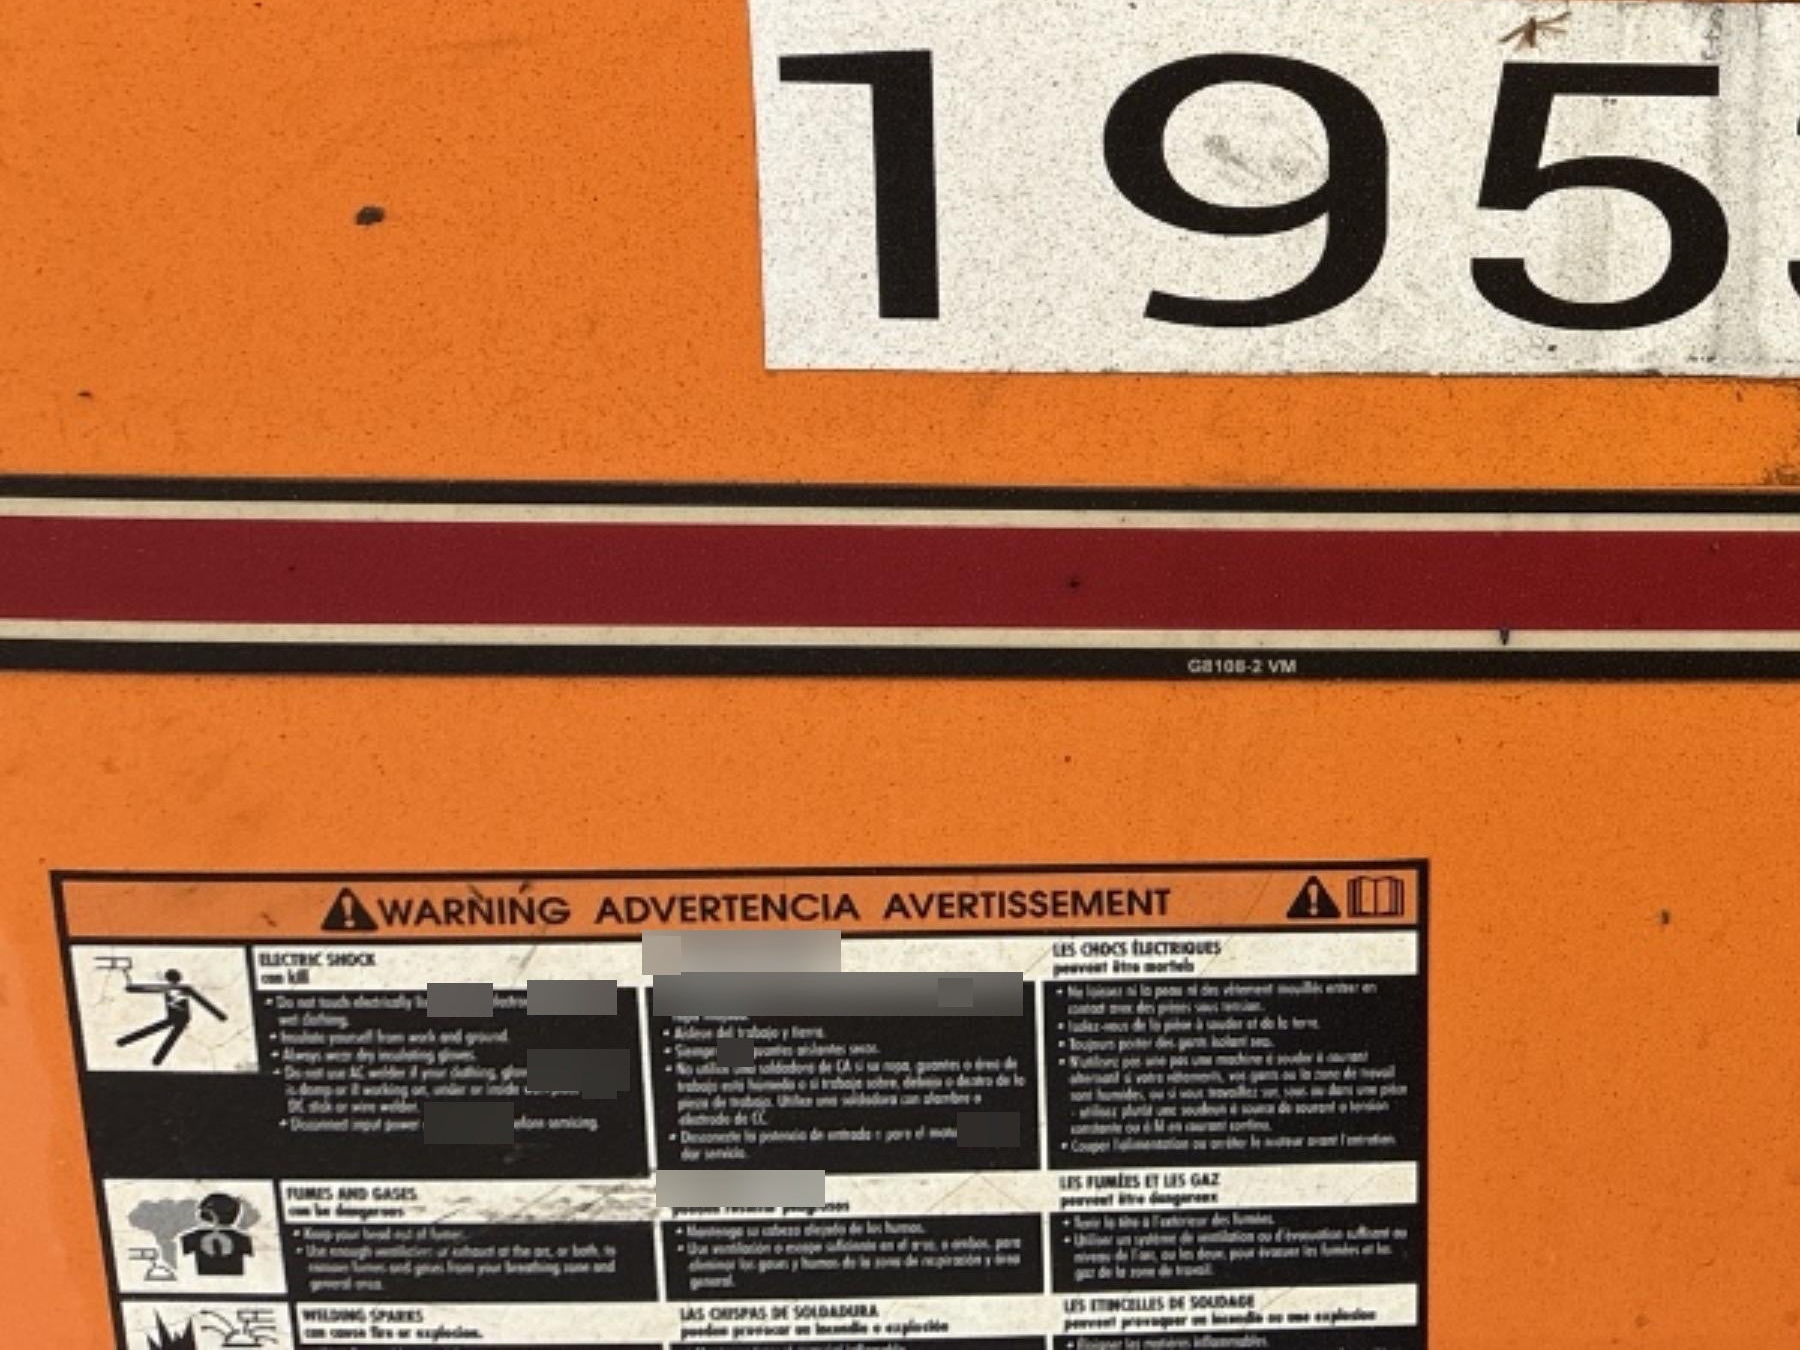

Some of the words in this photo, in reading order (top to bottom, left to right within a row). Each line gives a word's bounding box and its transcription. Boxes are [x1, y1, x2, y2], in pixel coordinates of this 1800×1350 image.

[1268, 658, 1297, 674] VM
[374, 895, 572, 928] WARNING
[594, 892, 860, 926] ADVERTENCIA
[884, 886, 1171, 922] AVERTISSEMENT
[1052, 943, 1075, 957] LES
[1081, 942, 1127, 956] CHOCS
[258, 953, 320, 966] ELECTRIC
[327, 954, 375, 966] SHOCK
[1058, 1175, 1082, 1189] LES
[1085, 1174, 1141, 1188] FUMÉES
[1144, 1174, 1160, 1188] ET
[1163, 1173, 1186, 1188] LES
[1190, 1173, 1220, 1186] GAZ
[286, 1188, 333, 1200] FUMES
[337, 1188, 368, 1200] AND
[372, 1188, 417, 1200] GASES
[1063, 1299, 1086, 1313] LES
[1168, 1297, 1185, 1310] DE
[1190, 1296, 1255, 1308] SOUDAGE
[302, 1310, 365, 1322] WELDING
[371, 1310, 423, 1322] SPARKS
[679, 1308, 705, 1321] LAS
[709, 1308, 767, 1320] CHISPAS
[771, 1306, 789, 1320] DE
[793, 1305, 878, 1318] SOLDADURA
